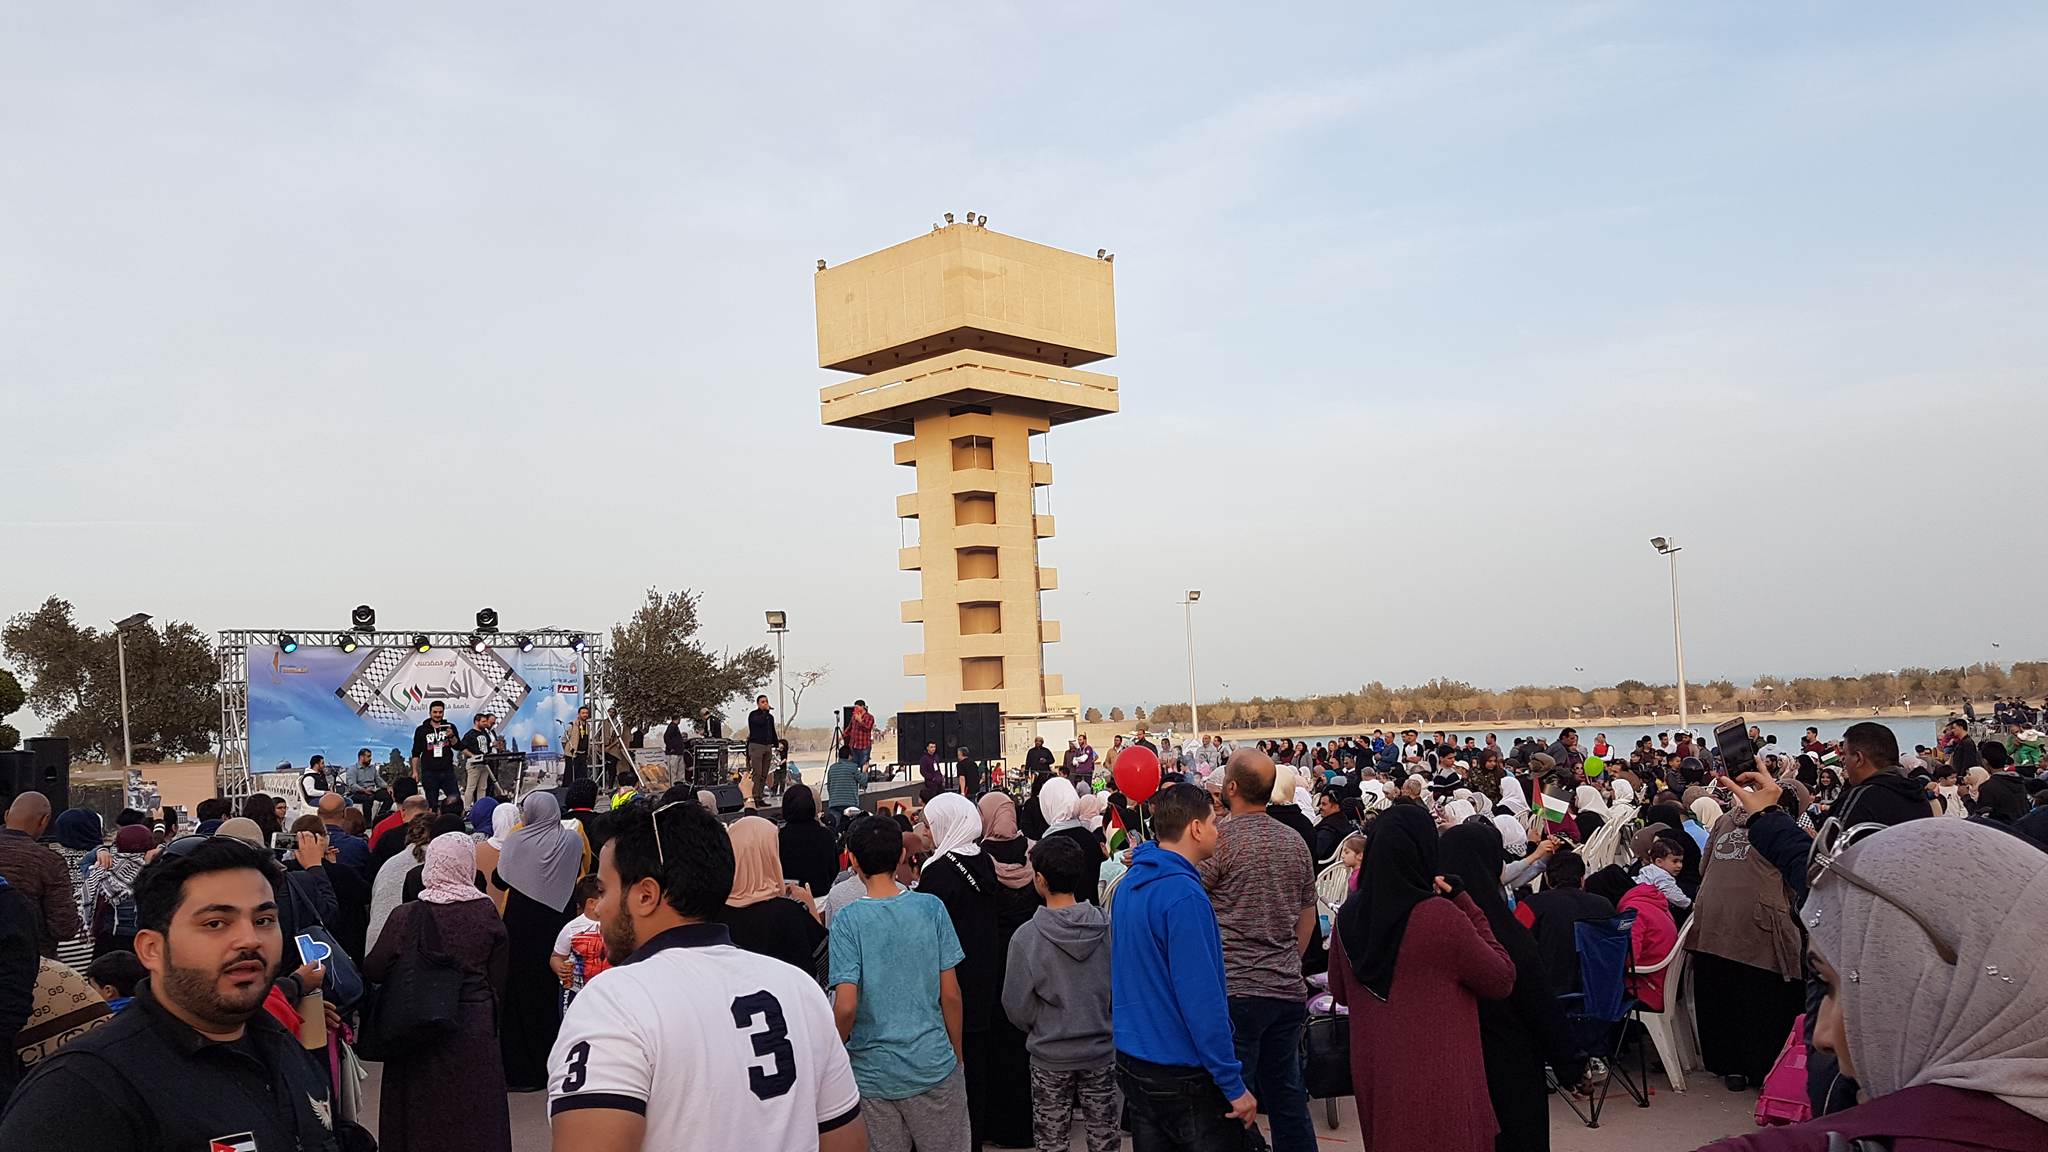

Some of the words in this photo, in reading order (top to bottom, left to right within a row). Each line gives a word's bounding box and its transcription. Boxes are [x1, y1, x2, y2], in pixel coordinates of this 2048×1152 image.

[390, 667, 488, 713] القدس
[562, 1041, 590, 1093] 3
[730, 989, 797, 1101] 3
